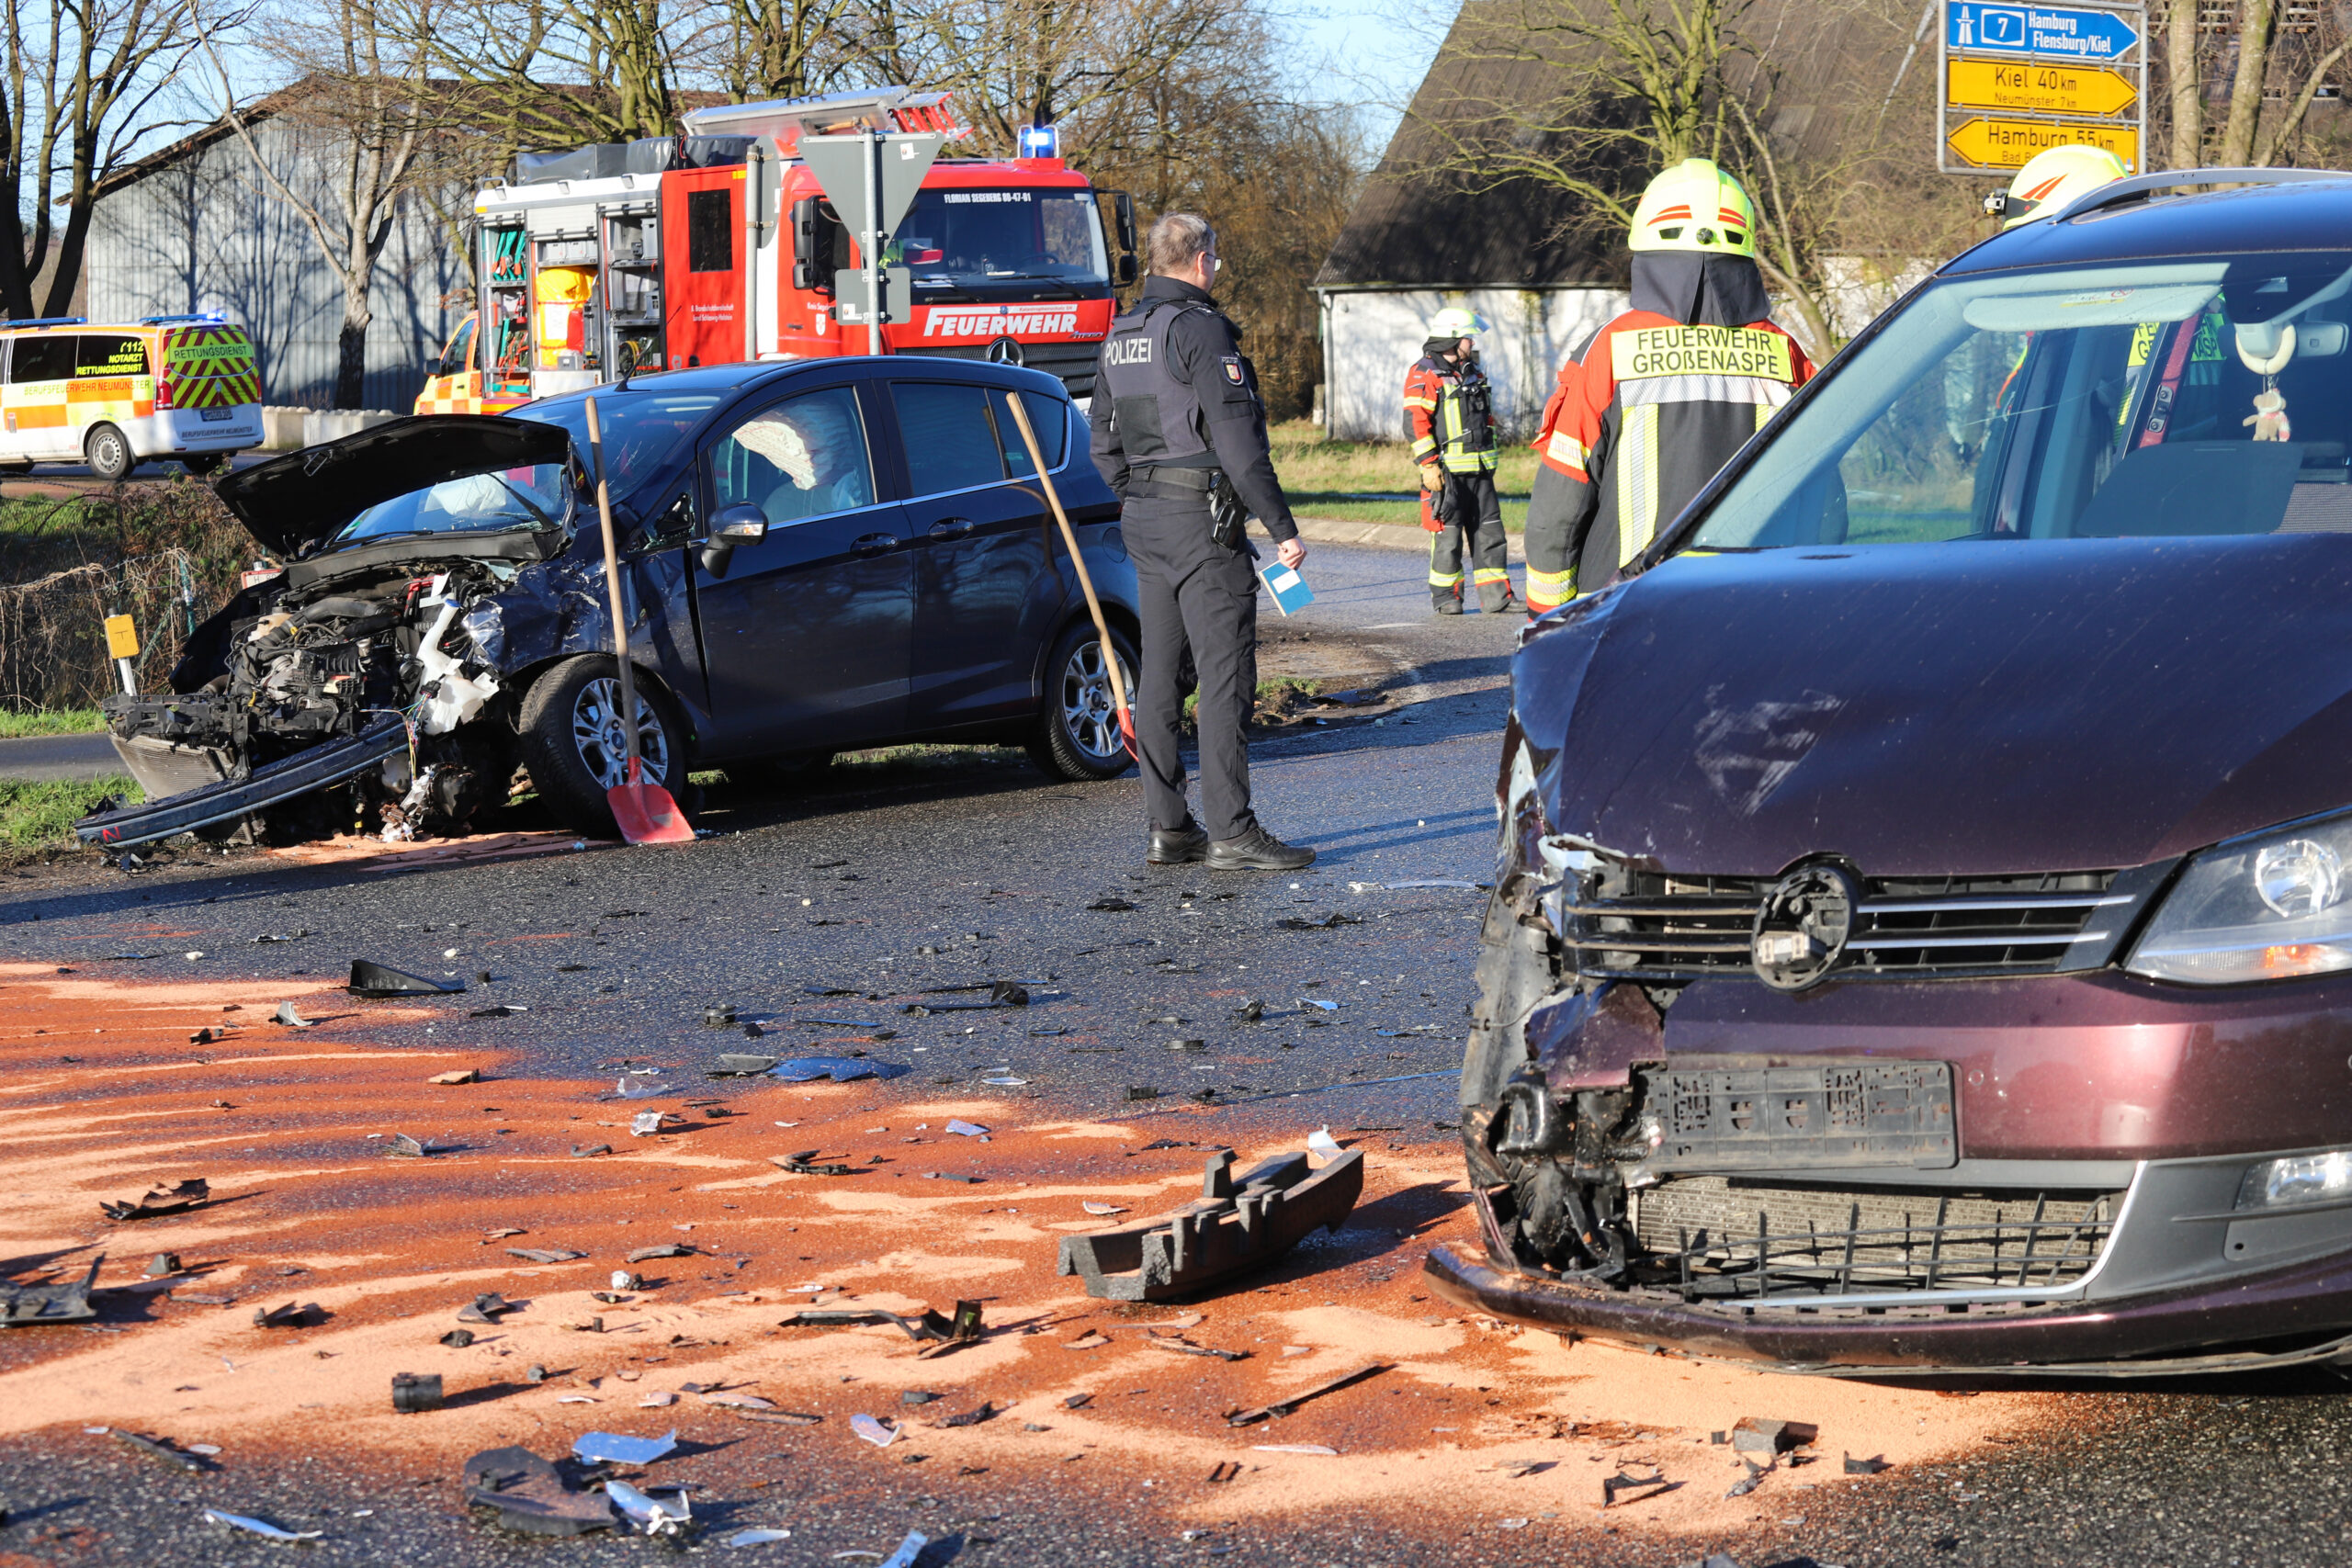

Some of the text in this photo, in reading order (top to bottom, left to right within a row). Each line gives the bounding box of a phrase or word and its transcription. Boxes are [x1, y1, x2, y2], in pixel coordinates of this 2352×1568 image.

[1997, 17, 2008, 38] 7
[2029, 11, 2076, 35] Hamburg
[2033, 31, 2112, 54] Flensburg/Kiel
[1996, 67, 2076, 92] Kiel 40 km
[1995, 92, 2055, 107] Neumünster
[1988, 124, 2067, 148] Hamburg
[2002, 151, 2020, 163] Bad
[944, 193, 971, 203] FLORIAN
[971, 192, 1002, 203] SEGEBERG
[127, 341, 144, 353] 112
[1637, 328, 1772, 352] FEUERWEHR
[108, 354, 143, 364] NOTARZT
[174, 345, 247, 358] RETTUNGSDIENST
[1106, 337, 1152, 367] POLIZEI
[76, 364, 143, 375] RETTUNGSDIENST
[1633, 350, 1781, 375] GROßENASPE
[24, 378, 150, 396] BERUFSFEUERWEHR NEUMÜNSTER
